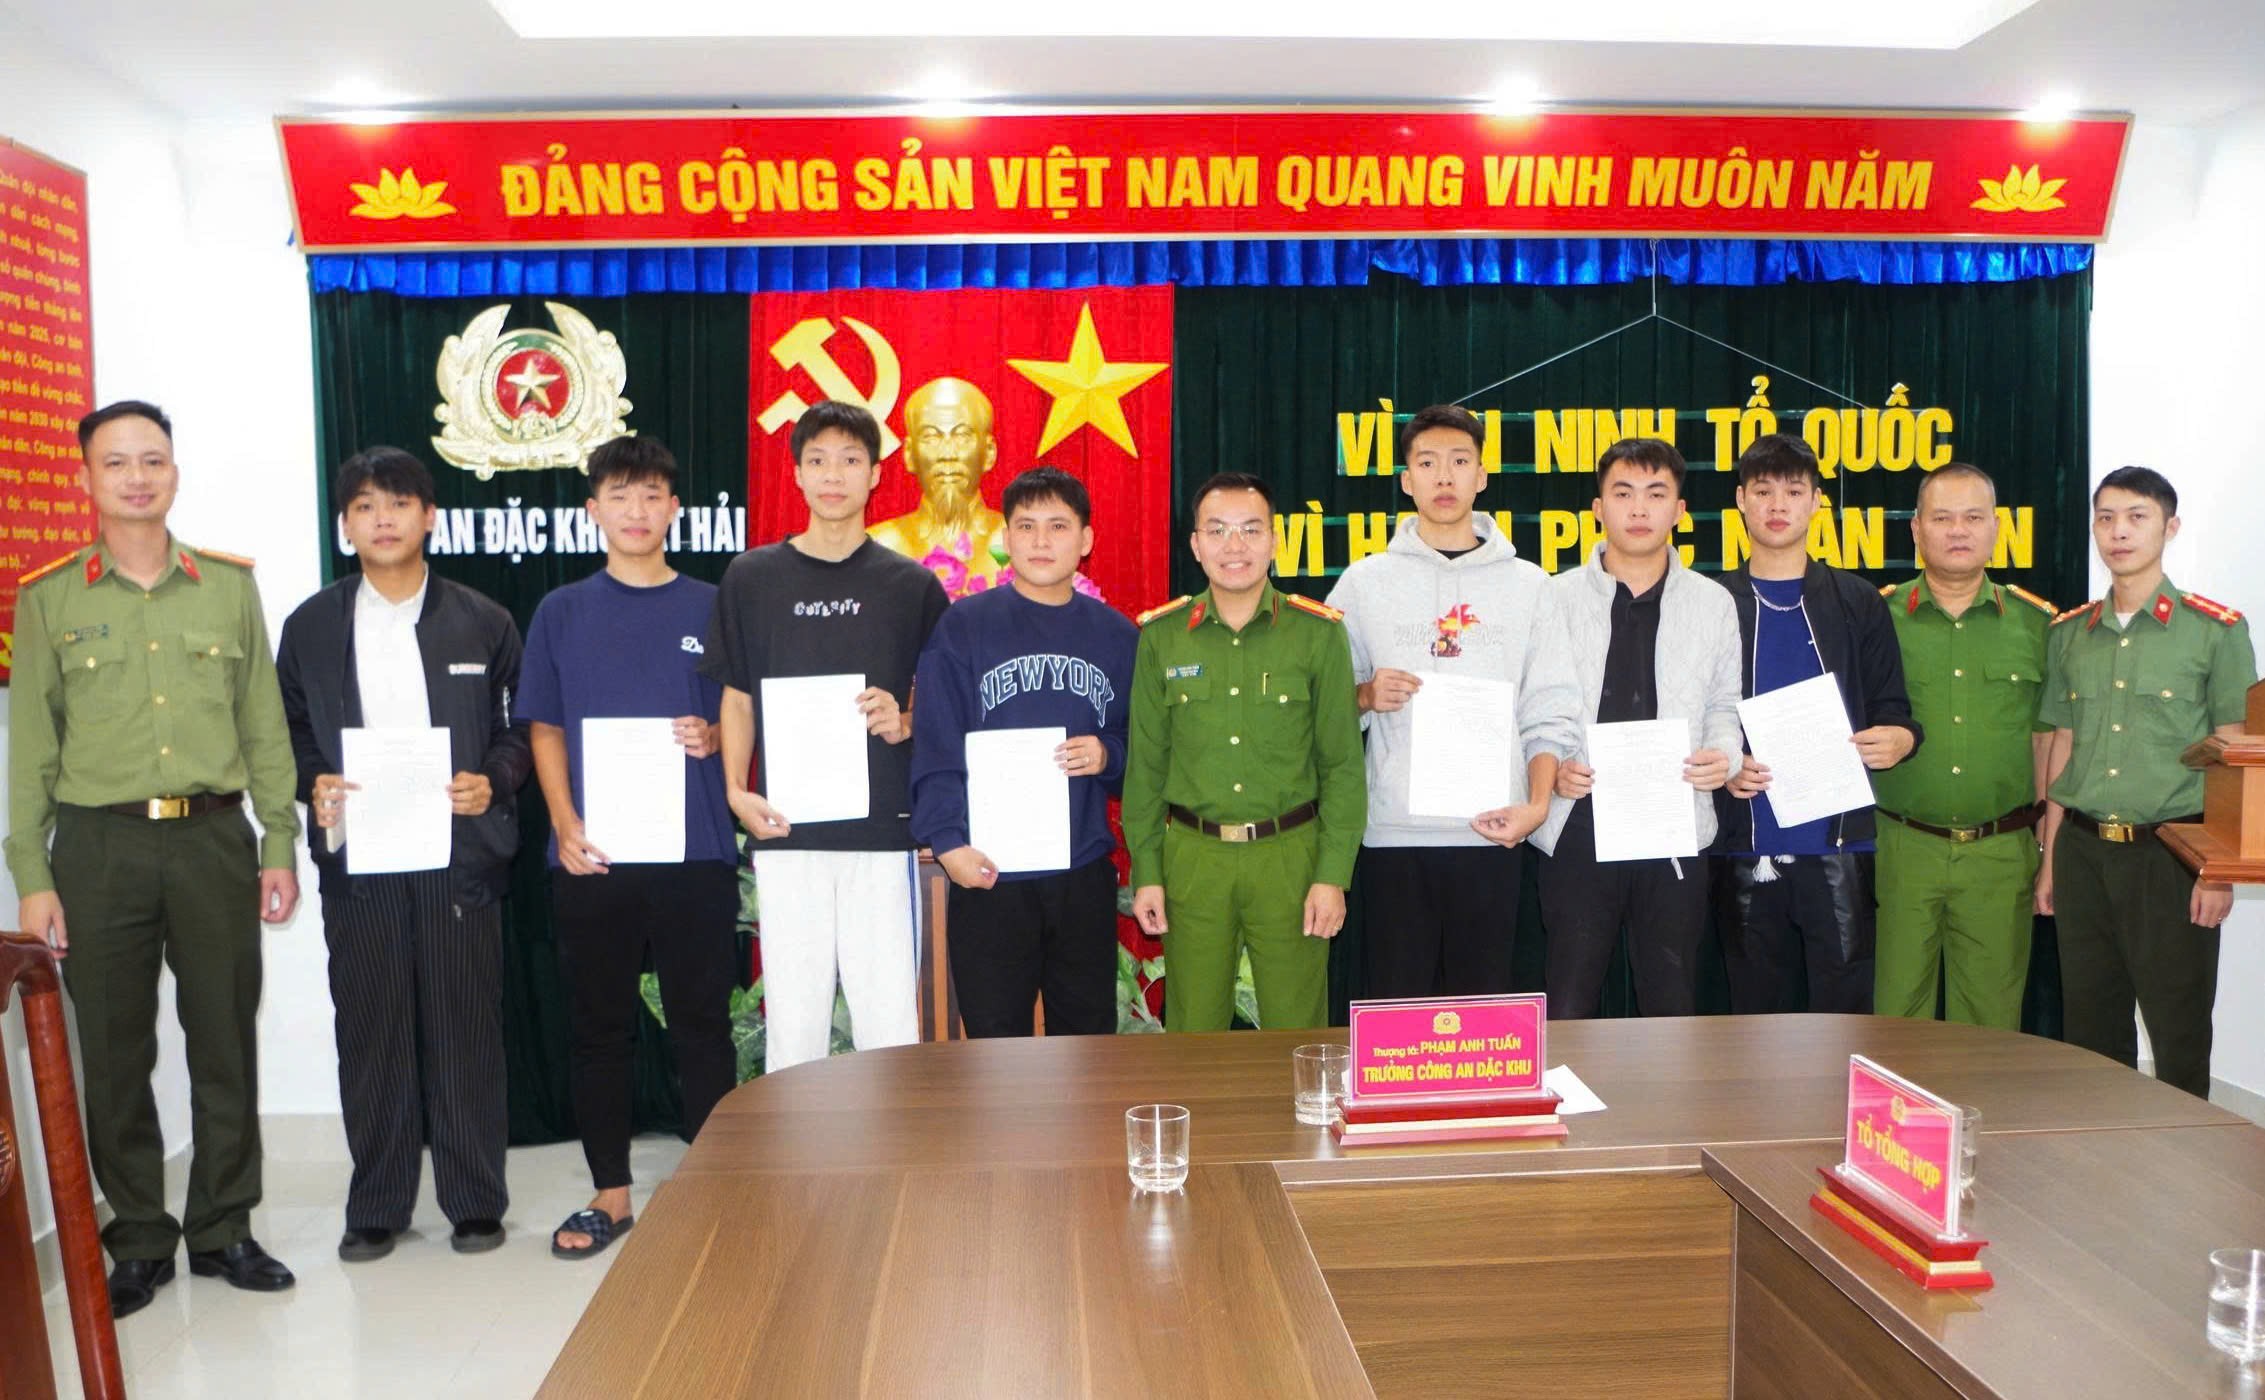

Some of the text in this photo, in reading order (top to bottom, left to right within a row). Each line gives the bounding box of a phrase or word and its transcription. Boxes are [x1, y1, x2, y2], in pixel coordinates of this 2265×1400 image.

[501, 137, 1933, 223] ĐẢNG CỘNG SẢN VIỆT NAM QUANG VINH MUÔN NĂM
[1337, 398, 1393, 476] VÌ
[1803, 382, 1953, 479] QUỐC
[429, 508, 476, 554] AN
[483, 497, 548, 563] ĐẶC
[554, 506, 608, 553] KH
[689, 491, 746, 553] HẢI
[1273, 500, 1324, 577] VÌ
[1362, 1059, 1414, 1083] TRƯỞNG
[1416, 1060, 1453, 1080] CÔNG
[1456, 1061, 1475, 1079] AN
[1505, 1059, 1532, 1076] KHU
[1420, 1040, 1457, 1056] PHẠM
[1458, 1039, 1486, 1053] ANH
[1487, 1033, 1522, 1050] TUẤN
[1856, 1113, 1941, 1195] TỔ TỔNG HỢP
